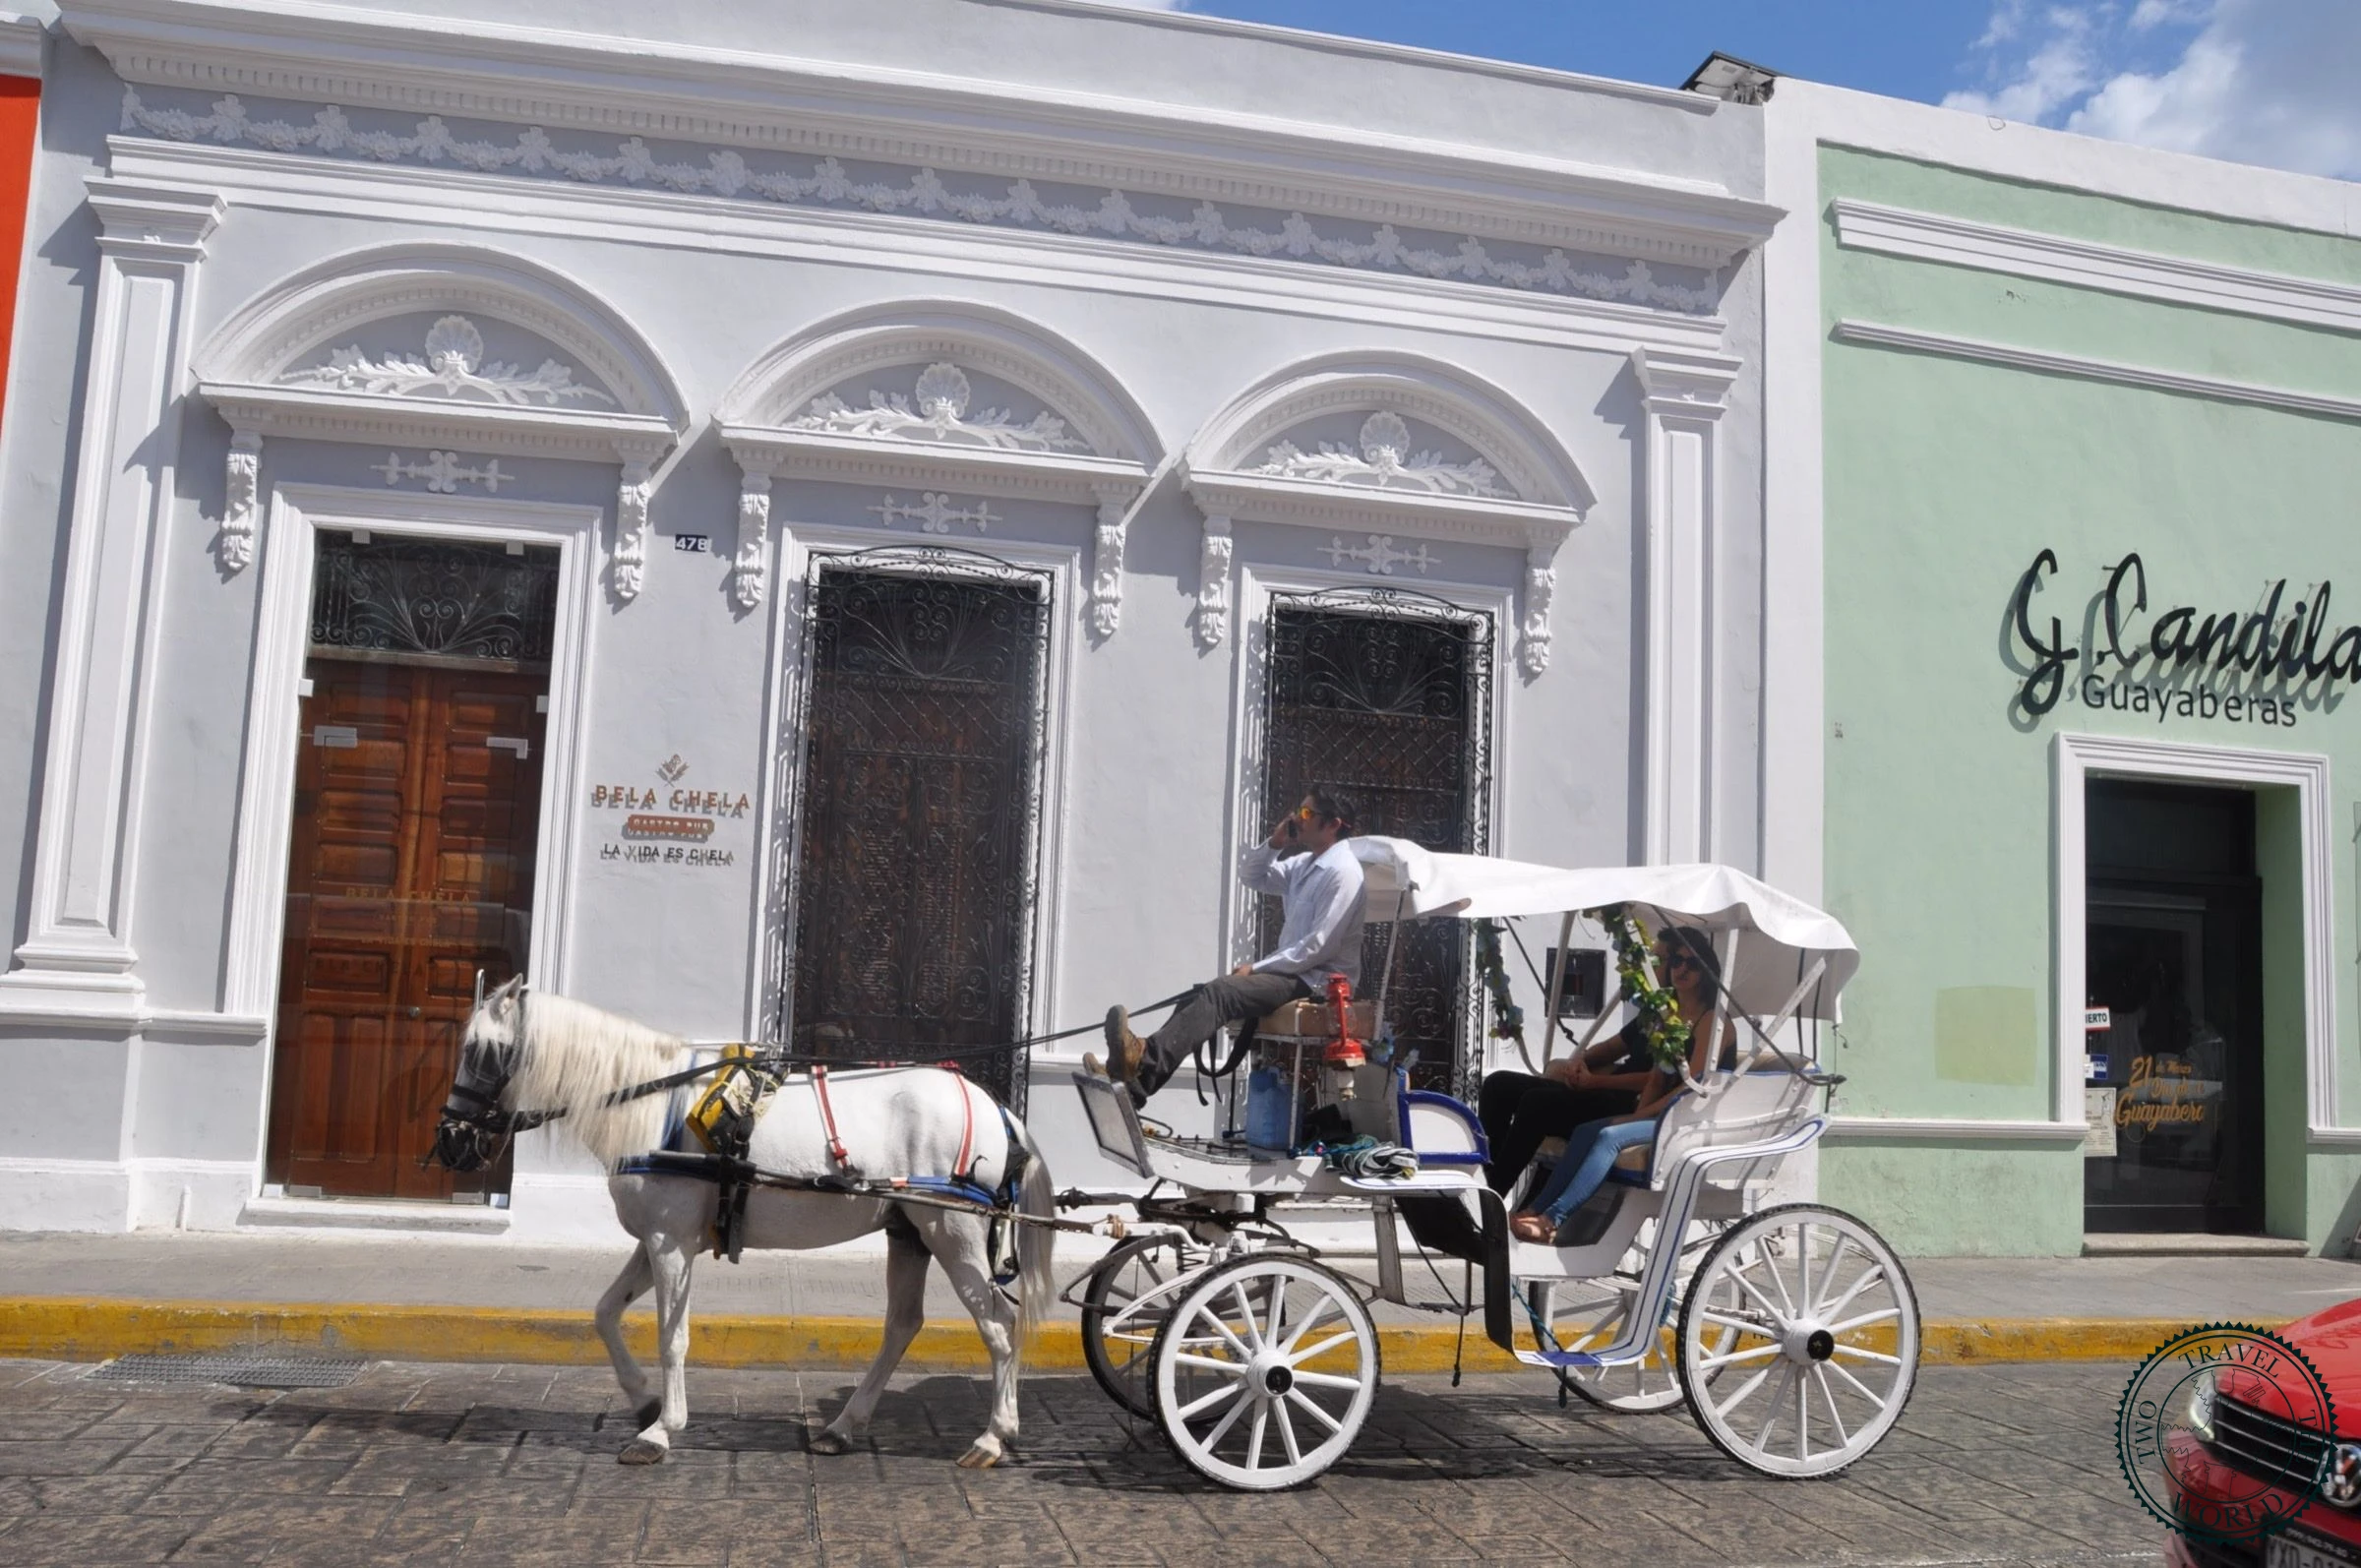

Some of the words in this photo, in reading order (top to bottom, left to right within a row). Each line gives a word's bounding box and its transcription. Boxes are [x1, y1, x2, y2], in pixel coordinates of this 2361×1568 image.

[677, 537, 707, 551] 478
[2104, 552, 2361, 685] Candila
[2082, 674, 2298, 728] Guayaberas
[595, 785, 657, 805] BELA
[673, 789, 751, 810] CHELA
[604, 843, 621, 855] LA
[628, 845, 660, 858] VIDA
[667, 847, 685, 859] ES
[690, 848, 735, 863] CHELA
[2085, 1012, 2108, 1023] IERTO
[2130, 1055, 2153, 1088] 21
